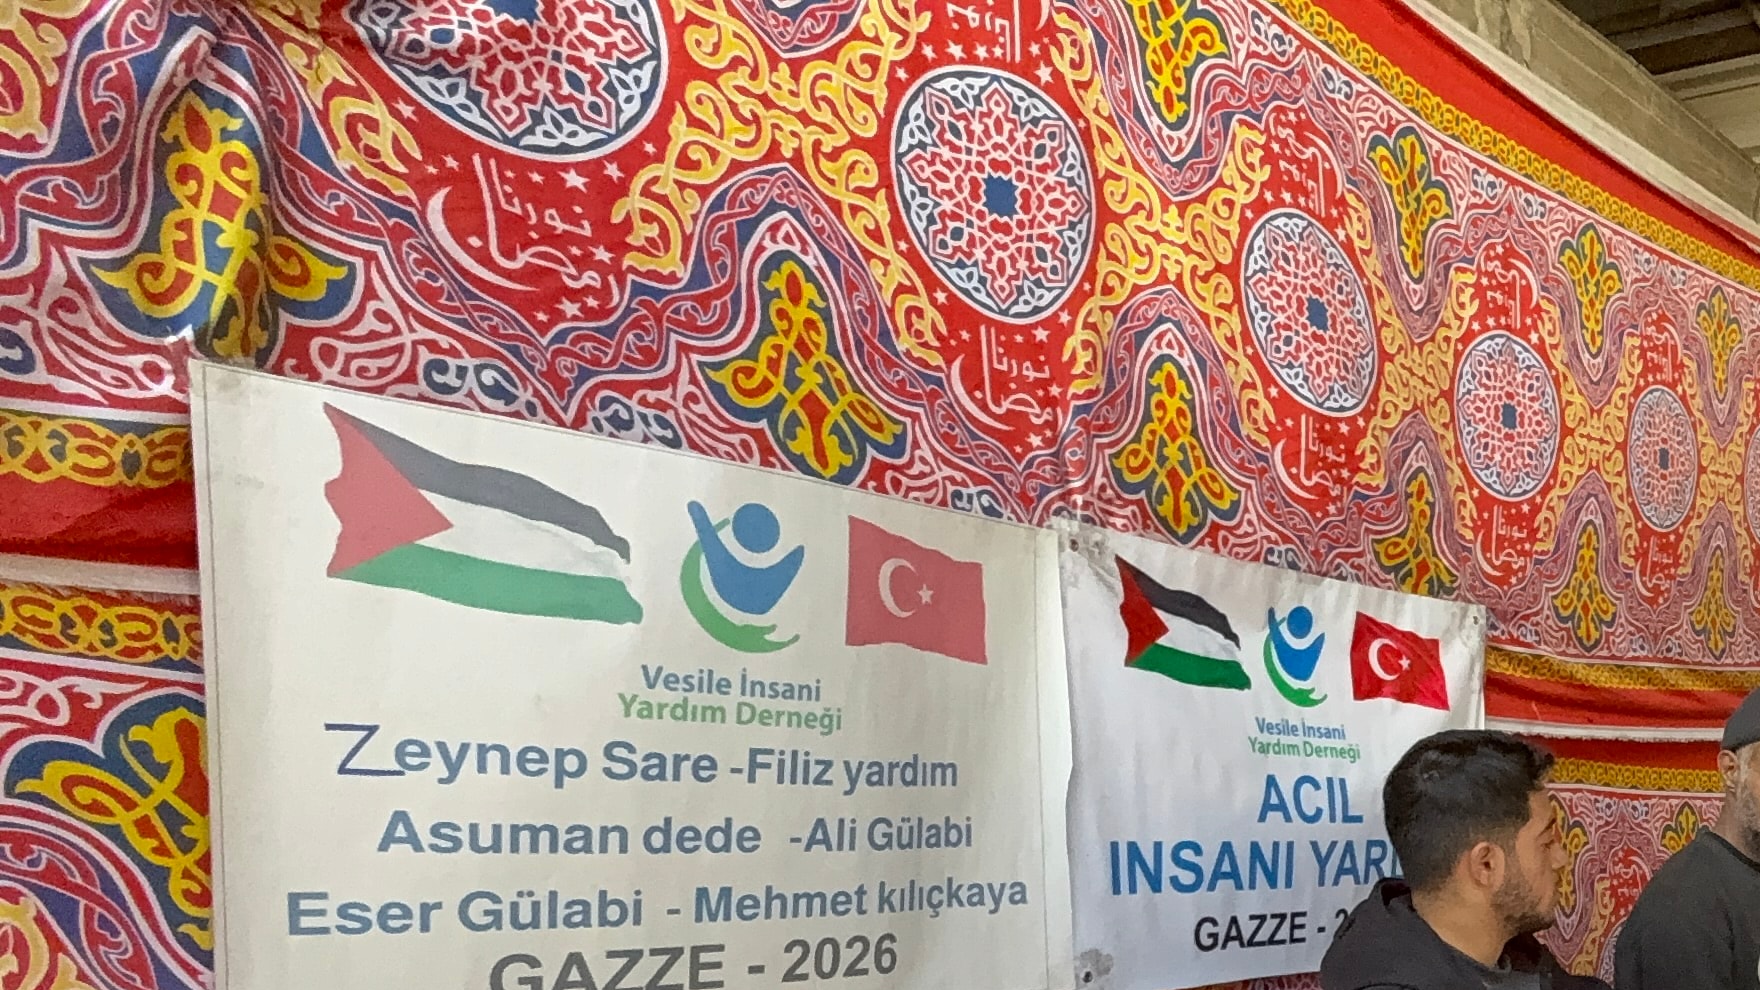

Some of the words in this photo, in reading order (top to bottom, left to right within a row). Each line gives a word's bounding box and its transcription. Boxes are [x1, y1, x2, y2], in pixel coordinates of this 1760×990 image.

[641, 664, 734, 697] Vesile
[739, 666, 822, 703] İnsani
[617, 692, 727, 726] Yardım
[735, 699, 843, 737] Derneği
[1255, 717, 1300, 738] Vesile
[1301, 718, 1346, 741] İnsani
[324, 723, 588, 789] Zeynep
[602, 740, 718, 784] Sare
[843, 753, 958, 796] yardım
[1247, 736, 1301, 757] Yardım
[1302, 740, 1361, 764] Derneği
[1257, 774, 1364, 825] ACIL
[377, 809, 630, 855] Asuman
[643, 817, 762, 855] dede
[867, 814, 973, 851] Gülabi
[1110, 840, 1295, 896] INSANI
[1309, 839, 1404, 887] YAR
[286, 891, 443, 936] Eser
[458, 887, 643, 933] Gülabi
[694, 882, 868, 923] Mehmet
[877, 876, 1028, 917] kılıçkaya
[1194, 911, 1308, 952] GAZZE
[781, 932, 898, 983] 2026
